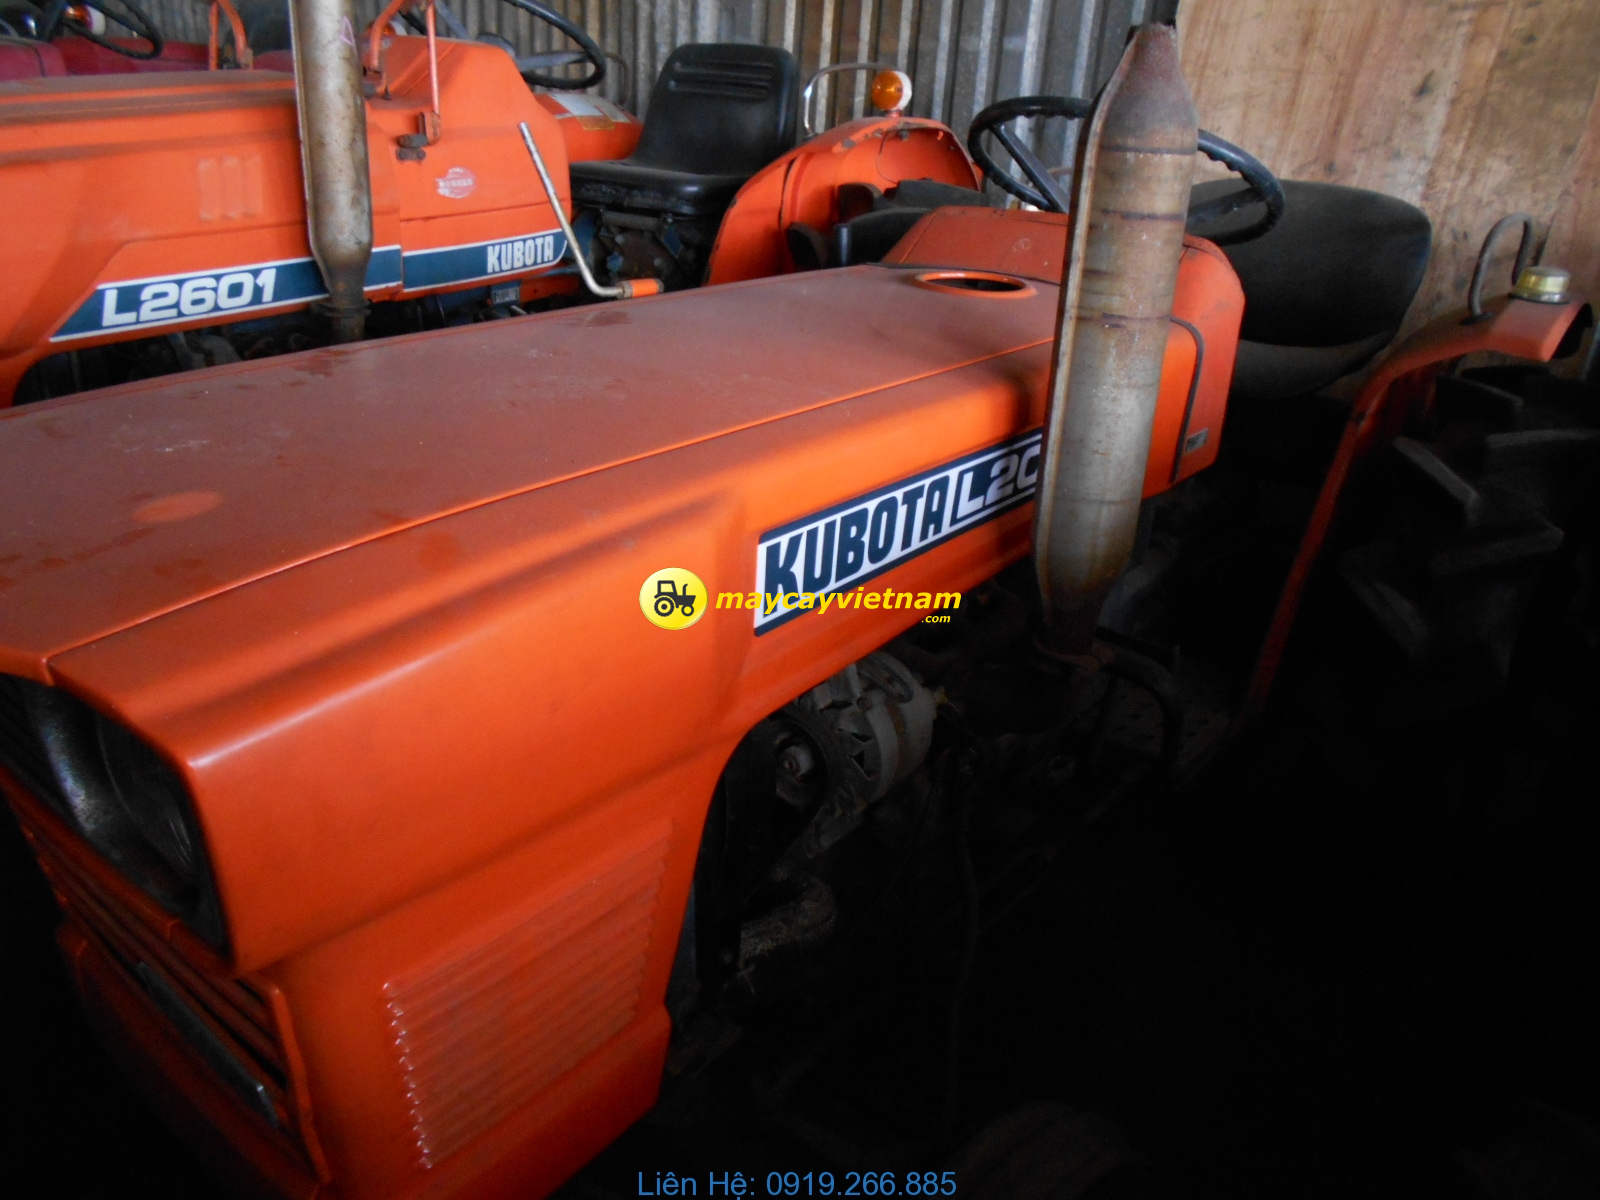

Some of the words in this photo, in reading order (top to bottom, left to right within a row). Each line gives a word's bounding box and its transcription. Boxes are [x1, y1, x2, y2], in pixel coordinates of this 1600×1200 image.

[486, 236, 555, 272] KUBOTA
[102, 268, 277, 328] L2601
[763, 475, 950, 618] KUBOTA
